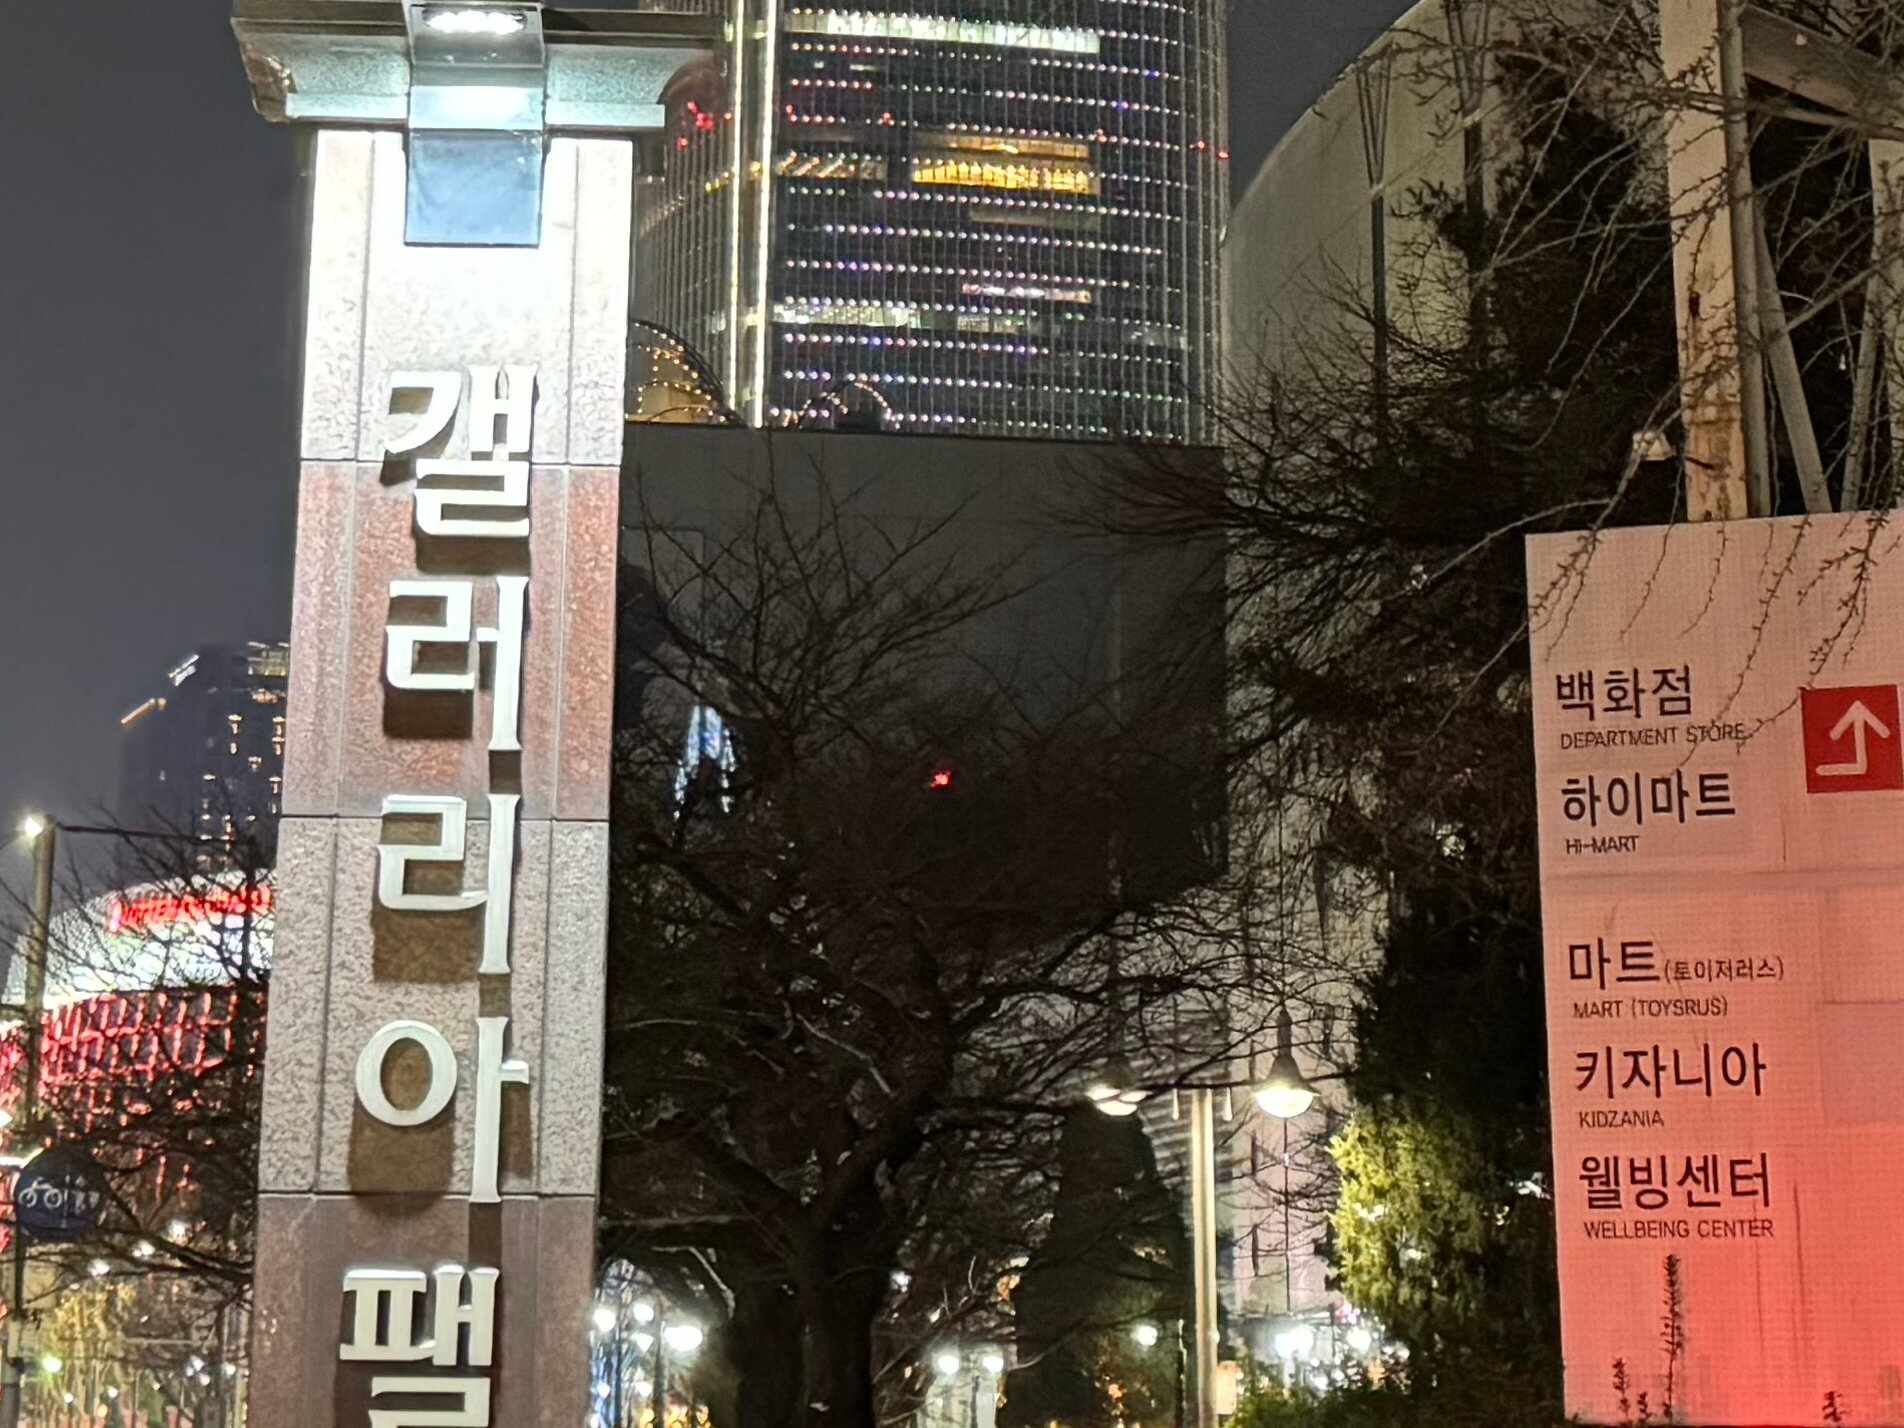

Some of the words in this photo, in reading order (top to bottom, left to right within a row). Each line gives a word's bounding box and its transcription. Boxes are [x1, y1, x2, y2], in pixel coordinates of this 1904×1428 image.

[1556, 664, 1692, 721] 백화점
[1560, 727, 1679, 750] DEPARTMENT
[1686, 722, 1746, 744] STORE
[1561, 768, 1736, 827] 하이마트
[1573, 999, 1623, 1019] MART
[1631, 995, 1729, 1018] (TOYSRUS)
[1575, 1042, 1767, 1100] 키자니아
[1578, 1109, 1665, 1128] KIDZANIA
[1579, 1152, 1770, 1210] 웰빙센터
[1584, 1220, 1690, 1240] WELLBEING
[1697, 1218, 1775, 1239] CENTER
